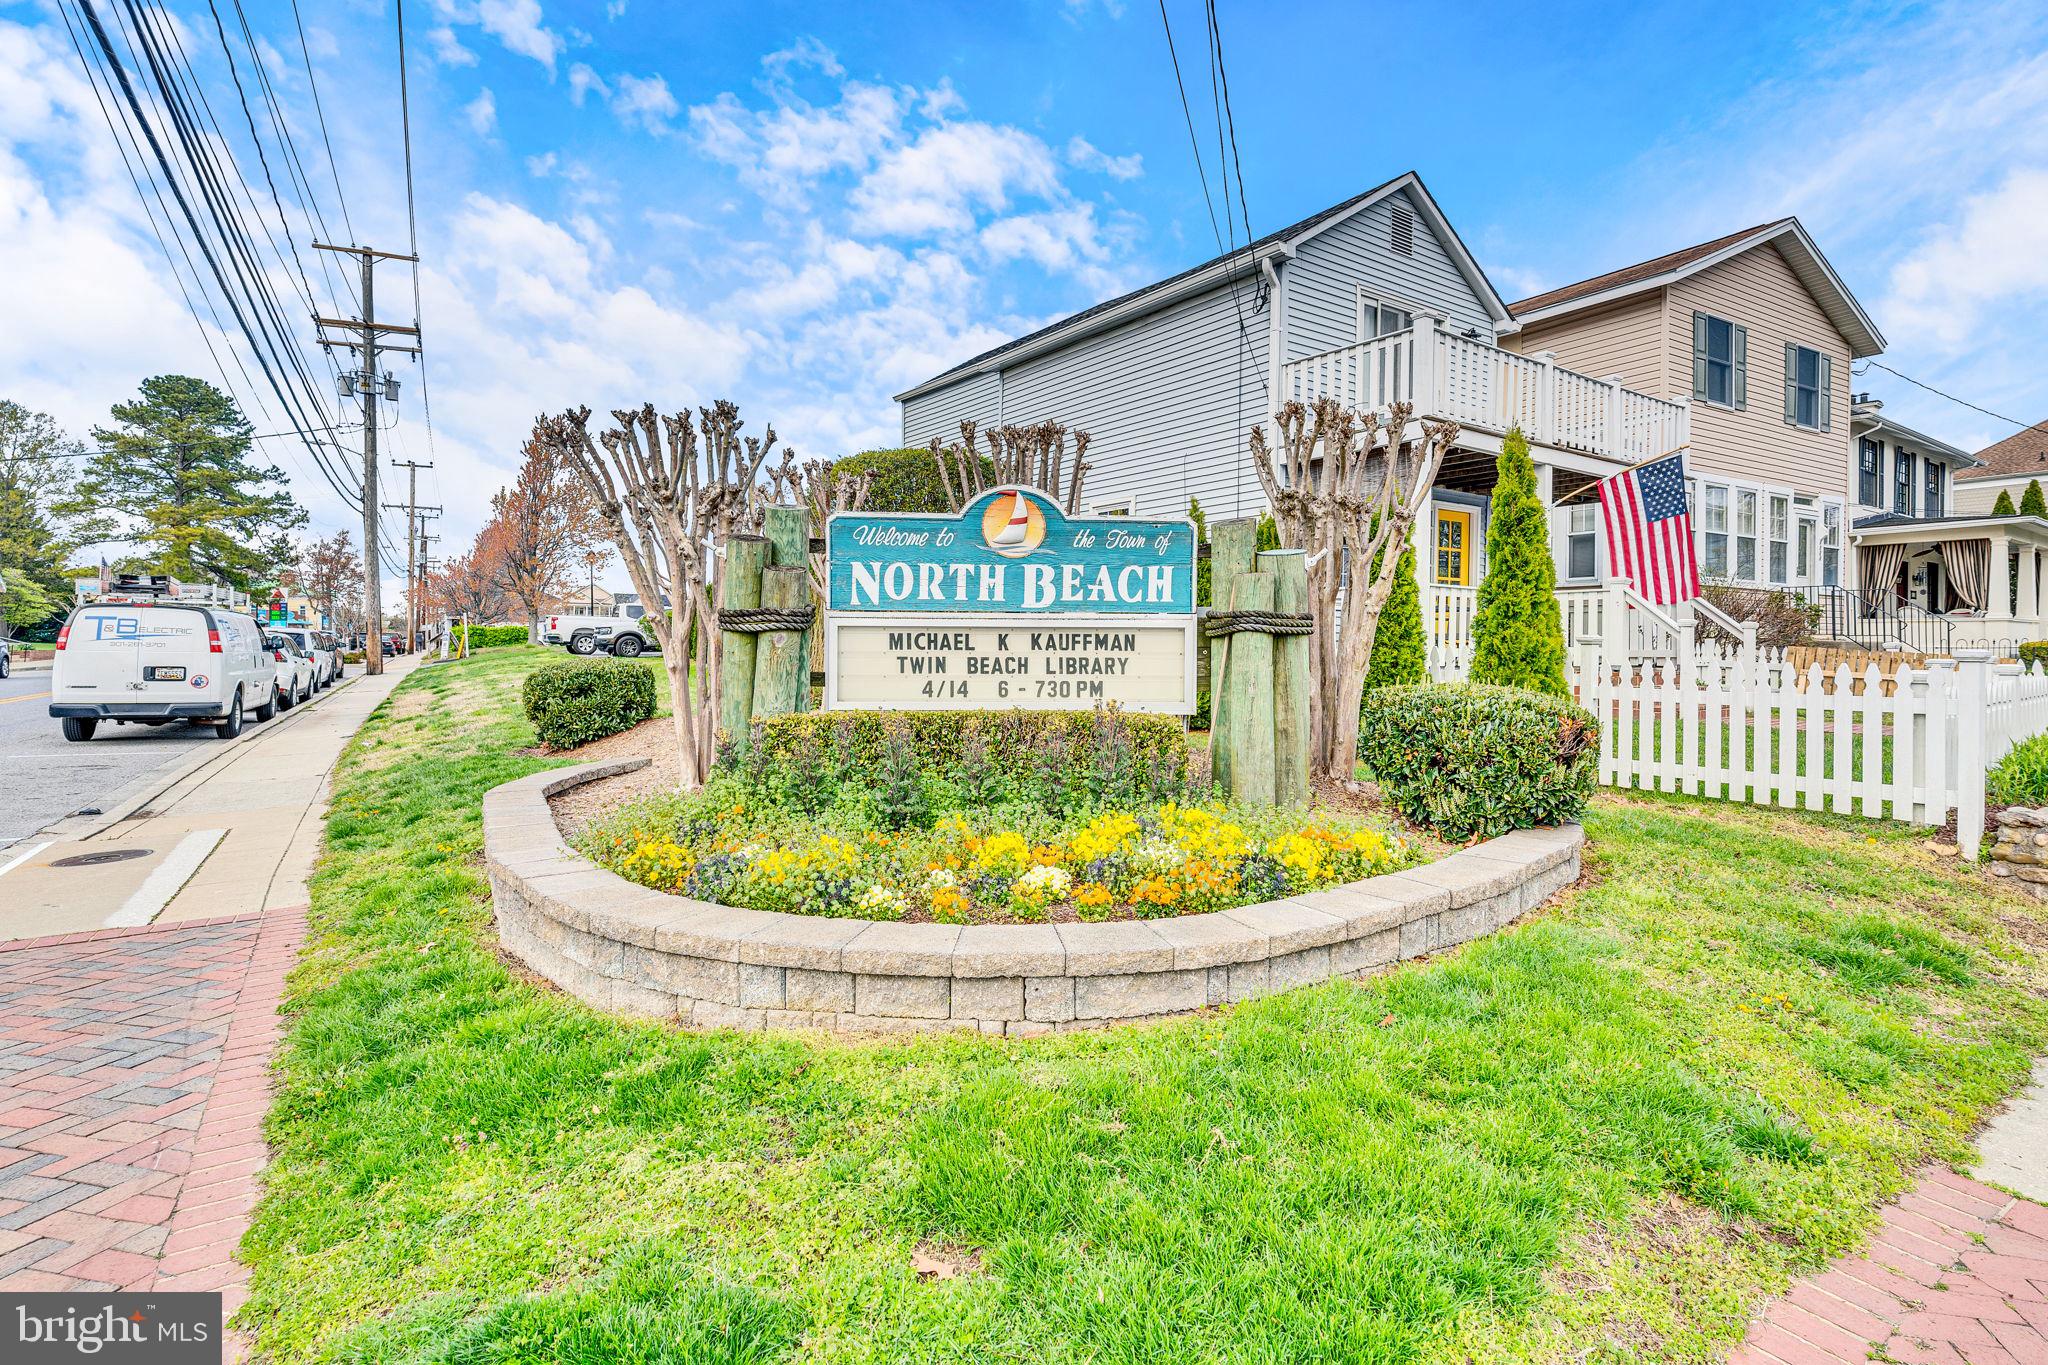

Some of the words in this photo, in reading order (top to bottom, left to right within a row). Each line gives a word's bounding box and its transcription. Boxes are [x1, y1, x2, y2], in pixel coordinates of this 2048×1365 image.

[853, 525, 929, 547] Welcome
[936, 527, 956, 547] to
[1073, 528, 1096, 548] the
[1105, 529, 1146, 549] Town
[1154, 530, 1173, 556] of
[850, 561, 1006, 606] NORTH
[1021, 563, 1175, 608] BEACH
[139, 626, 192, 634] ELECTRIC
[889, 633, 975, 650] MICHAEL
[998, 634, 1009, 650] K
[1031, 633, 1136, 651] KAUFFMAN
[897, 657, 946, 674] TWIN
[967, 657, 1029, 674] BEACH
[1046, 657, 1129, 675] LIBRARY
[922, 680, 968, 698] 4/14
[998, 680, 1009, 698] 6
